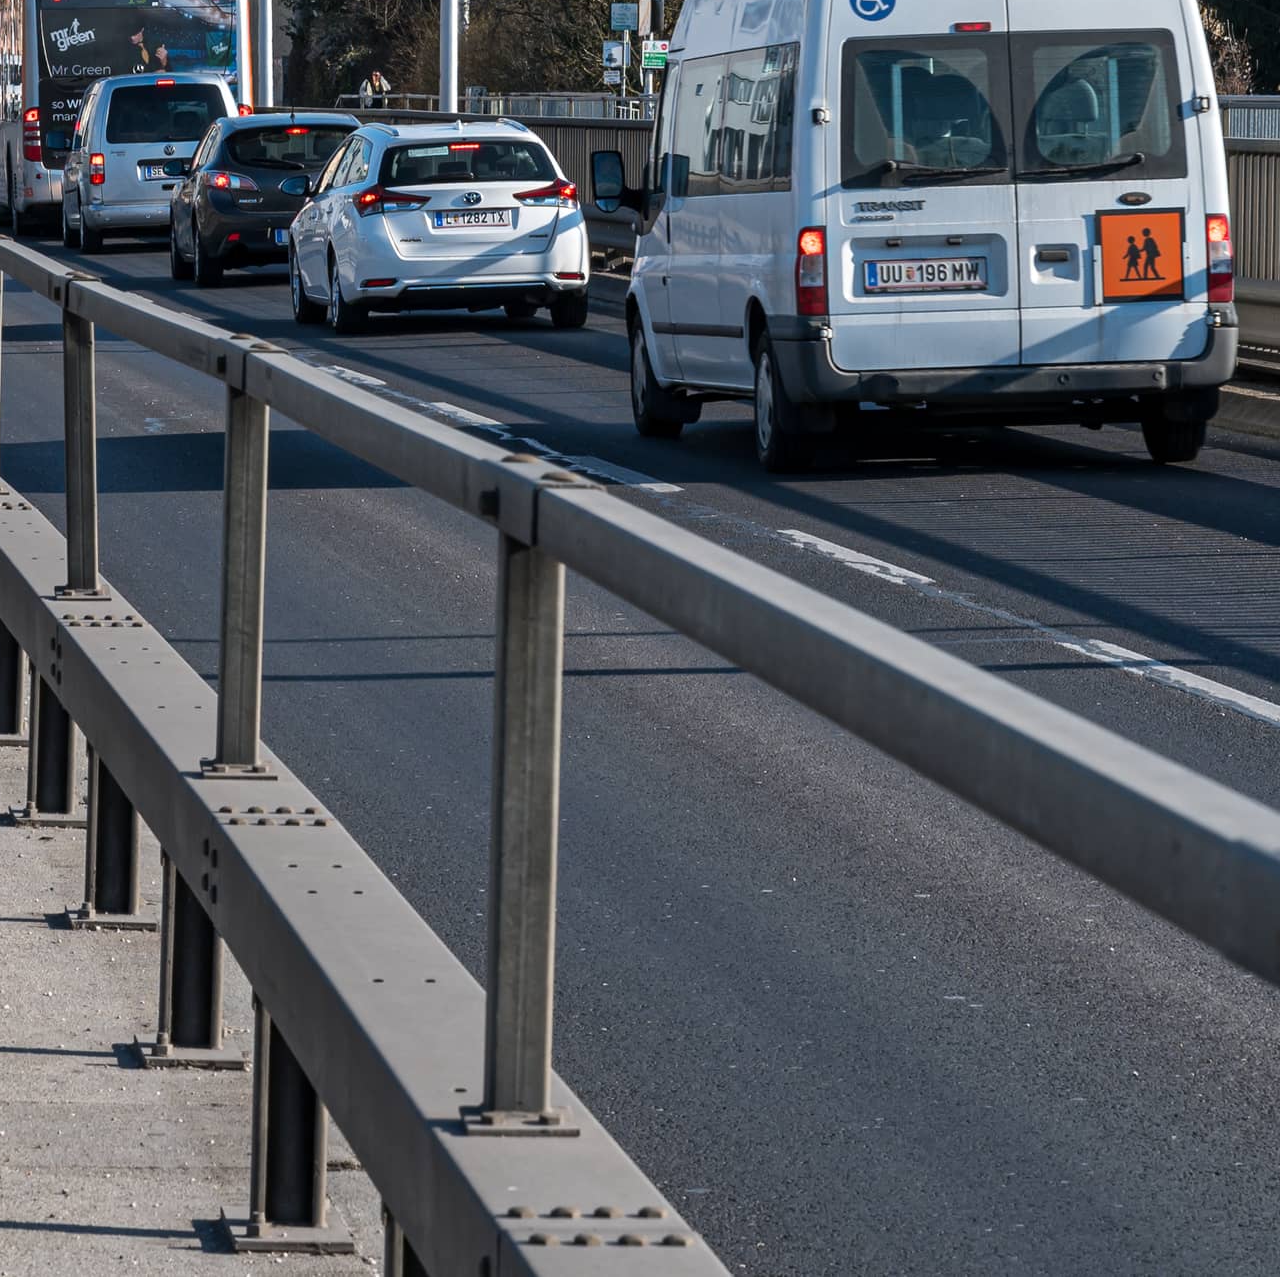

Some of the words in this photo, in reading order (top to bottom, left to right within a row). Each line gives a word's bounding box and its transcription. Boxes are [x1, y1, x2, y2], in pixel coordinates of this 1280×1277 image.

[50, 28, 69, 42] mr
[56, 30, 96, 52] green
[52, 65, 68, 75] Mr
[72, 64, 111, 75] Green
[51, 101, 65, 109] so
[856, 200, 927, 212] TRANSIT
[446, 212, 453, 224] L
[462, 209, 488, 224] 1282
[491, 210, 505, 223] TX
[880, 265, 903, 283] UU
[917, 263, 948, 283] 196
[952, 262, 980, 282] MW
